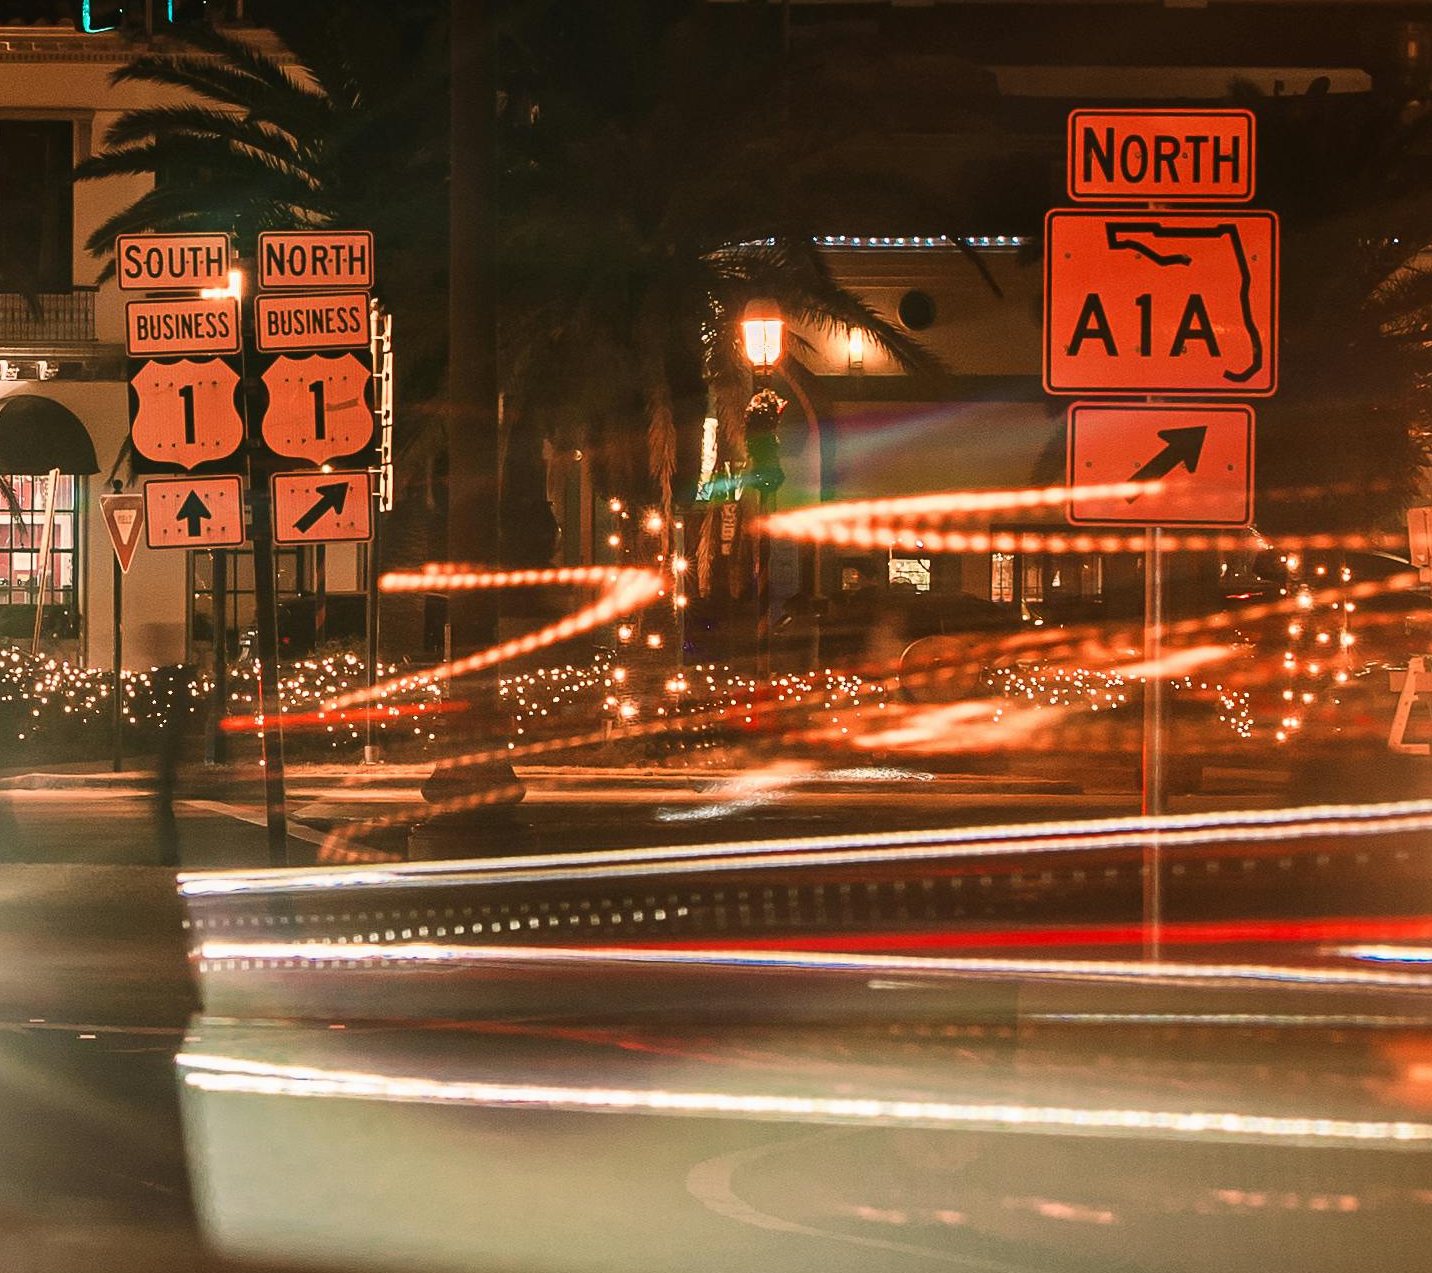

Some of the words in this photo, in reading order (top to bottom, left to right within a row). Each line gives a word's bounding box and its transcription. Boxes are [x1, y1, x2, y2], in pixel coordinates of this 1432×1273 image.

[1082, 126, 1240, 184] NORTH
[124, 244, 223, 279] SOUTH
[265, 242, 366, 277] NORTH
[136, 311, 230, 341] BUSINESS
[267, 306, 361, 337] BUSINESS
[1065, 292, 1222, 358] A1A
[178, 384, 196, 445] 1
[308, 379, 326, 441] 1
